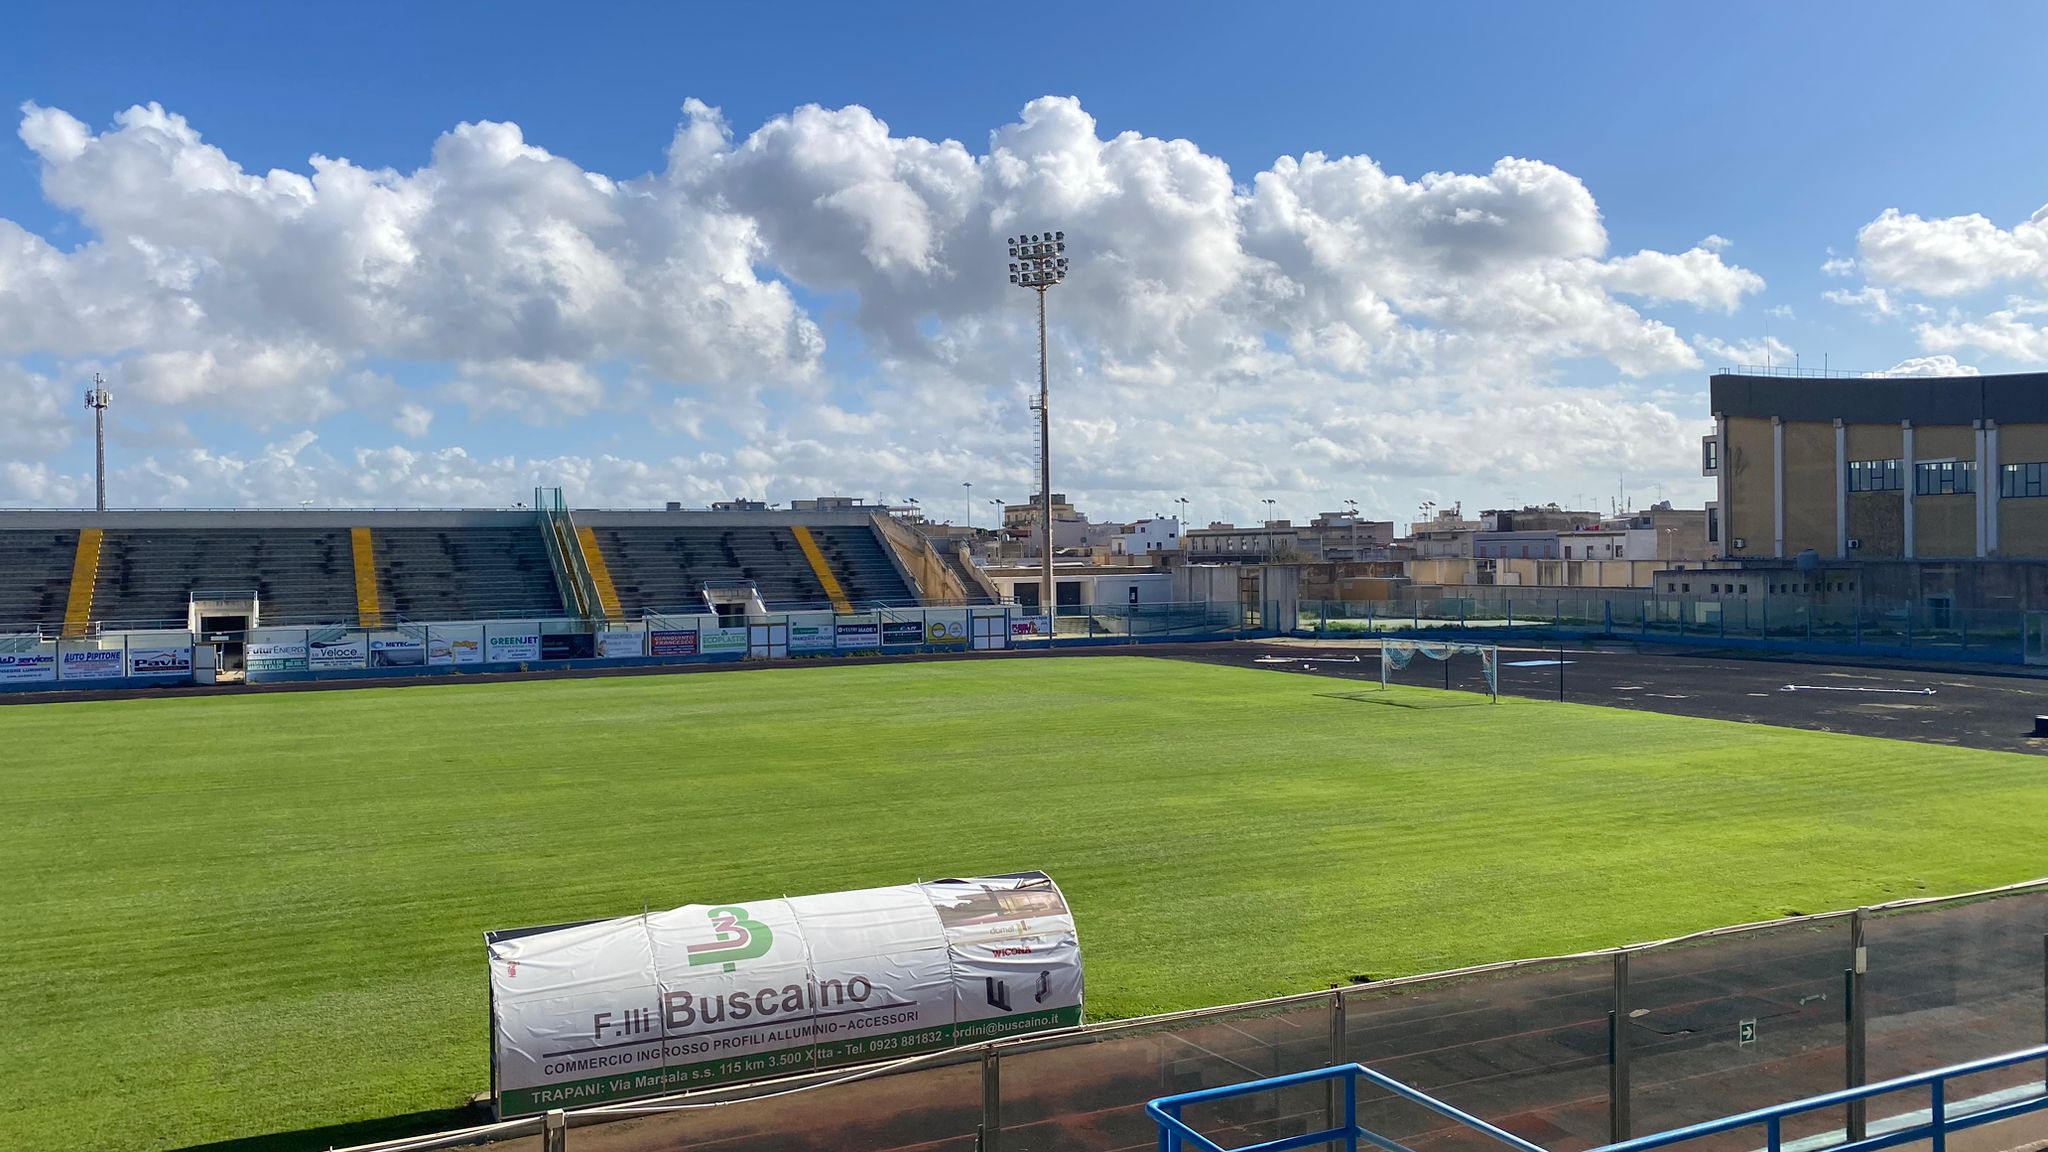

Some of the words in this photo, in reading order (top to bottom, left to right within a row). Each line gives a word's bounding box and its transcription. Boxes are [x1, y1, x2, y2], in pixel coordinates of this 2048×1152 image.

[490, 636, 538, 646] GREENJET
[703, 635, 746, 644] ECOPLASTIK
[64, 652, 85, 663] AUTO
[86, 651, 121, 662] PIPITONE
[320, 648, 357, 657] Veloce
[993, 946, 1032, 958] WICONA
[594, 1007, 650, 1040] F.lli
[663, 971, 872, 1030] Buscaino
[531, 1083, 605, 1104] TRAPANI:
[609, 1078, 631, 1092] Via
[635, 1070, 688, 1089] Marsala
[692, 1070, 715, 1080] s.s.
[719, 1061, 742, 1075] 115
[745, 1058, 765, 1071] km
[768, 1052, 801, 1067] 3.500
[845, 1044, 866, 1056] Tel.
[869, 1037, 898, 1052] 0923
[901, 1031, 942, 1047] 881832
[952, 1013, 1059, 1039] ordini@buscaino.it
[544, 1053, 633, 1076] COMMERCIO
[637, 1038, 709, 1060] INGROSSO
[713, 1033, 765, 1051] PROFILI
